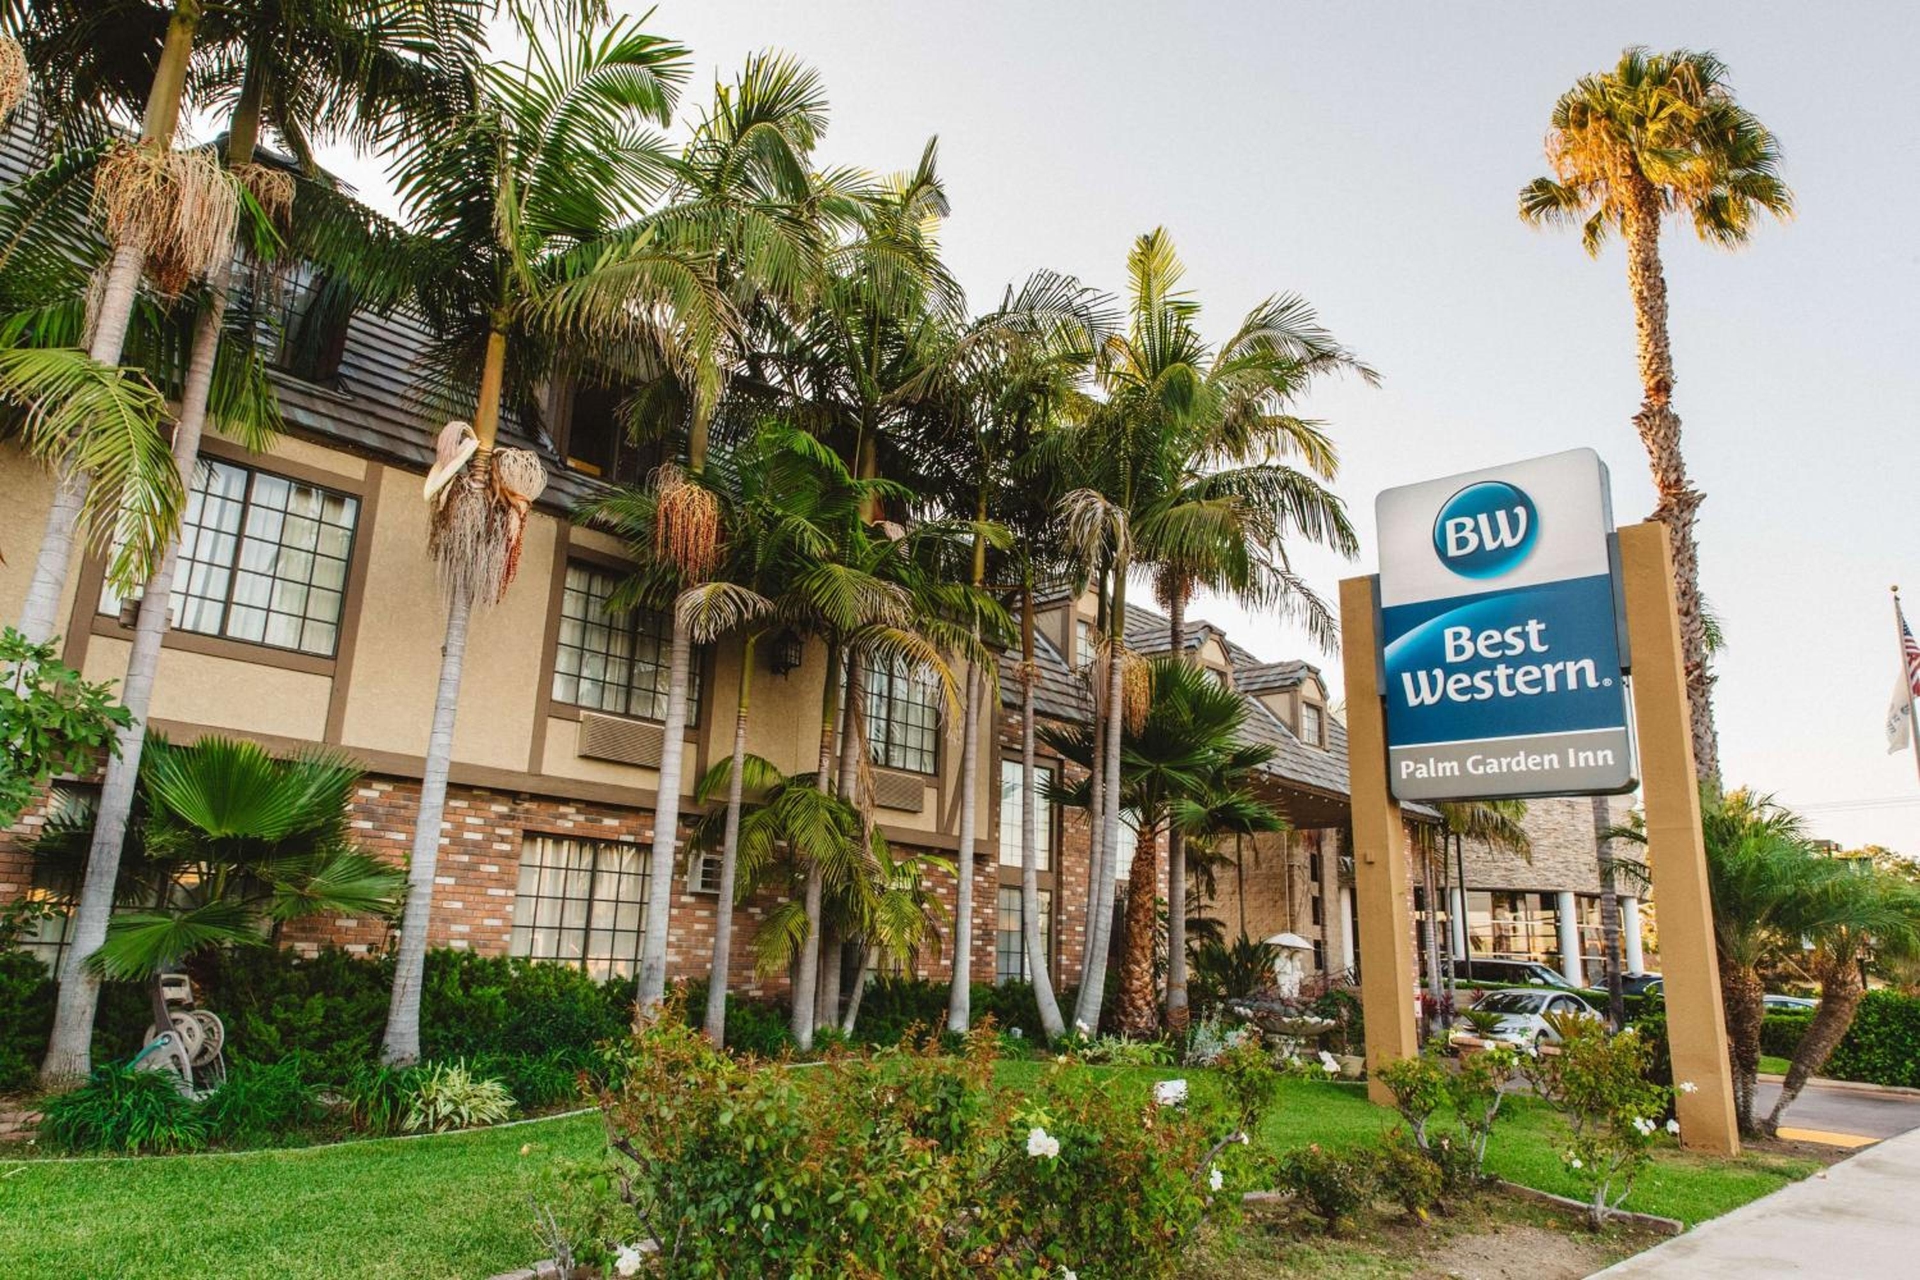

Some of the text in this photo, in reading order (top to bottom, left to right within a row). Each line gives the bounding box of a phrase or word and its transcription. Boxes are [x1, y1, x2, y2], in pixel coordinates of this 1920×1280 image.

[1445, 505, 1528, 557] BW
[1443, 618, 1549, 663] Best
[1400, 747, 1615, 779] Palm Garden Inn
